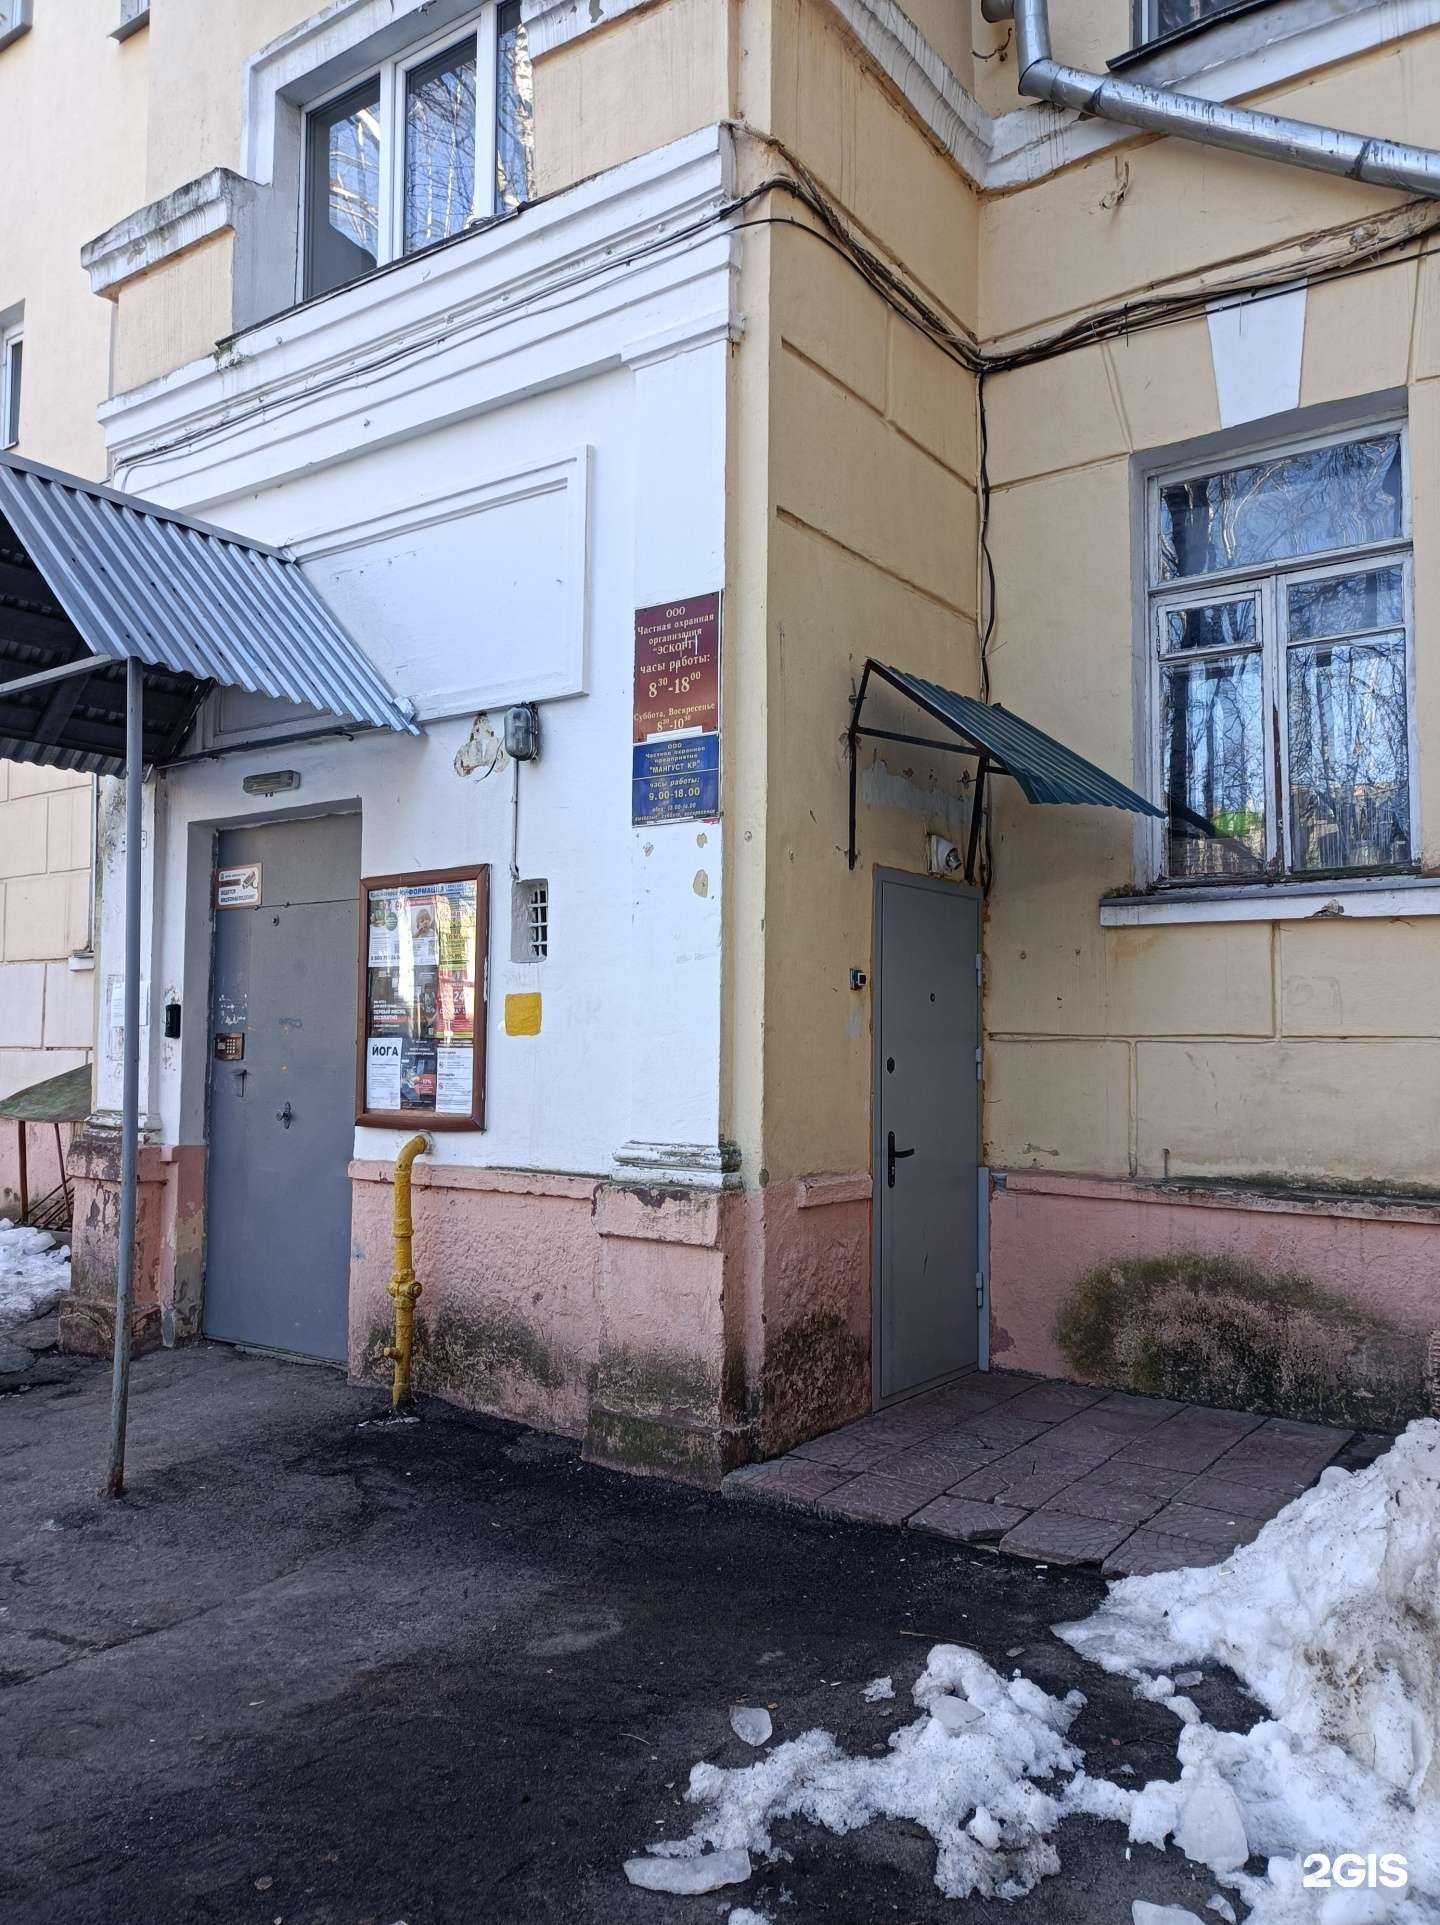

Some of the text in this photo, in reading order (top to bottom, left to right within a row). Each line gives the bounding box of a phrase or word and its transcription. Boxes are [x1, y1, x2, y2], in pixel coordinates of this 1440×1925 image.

[666, 606, 686, 618] ООО
[637, 613, 714, 635] Частная охранная
[648, 628, 702, 646] организация
[640, 654, 711, 674] часы работы:
[667, 742, 682, 750] ООО
[648, 787, 700, 801] 9.00-18.00
[371, 1044, 399, 1057] ЙОГА
